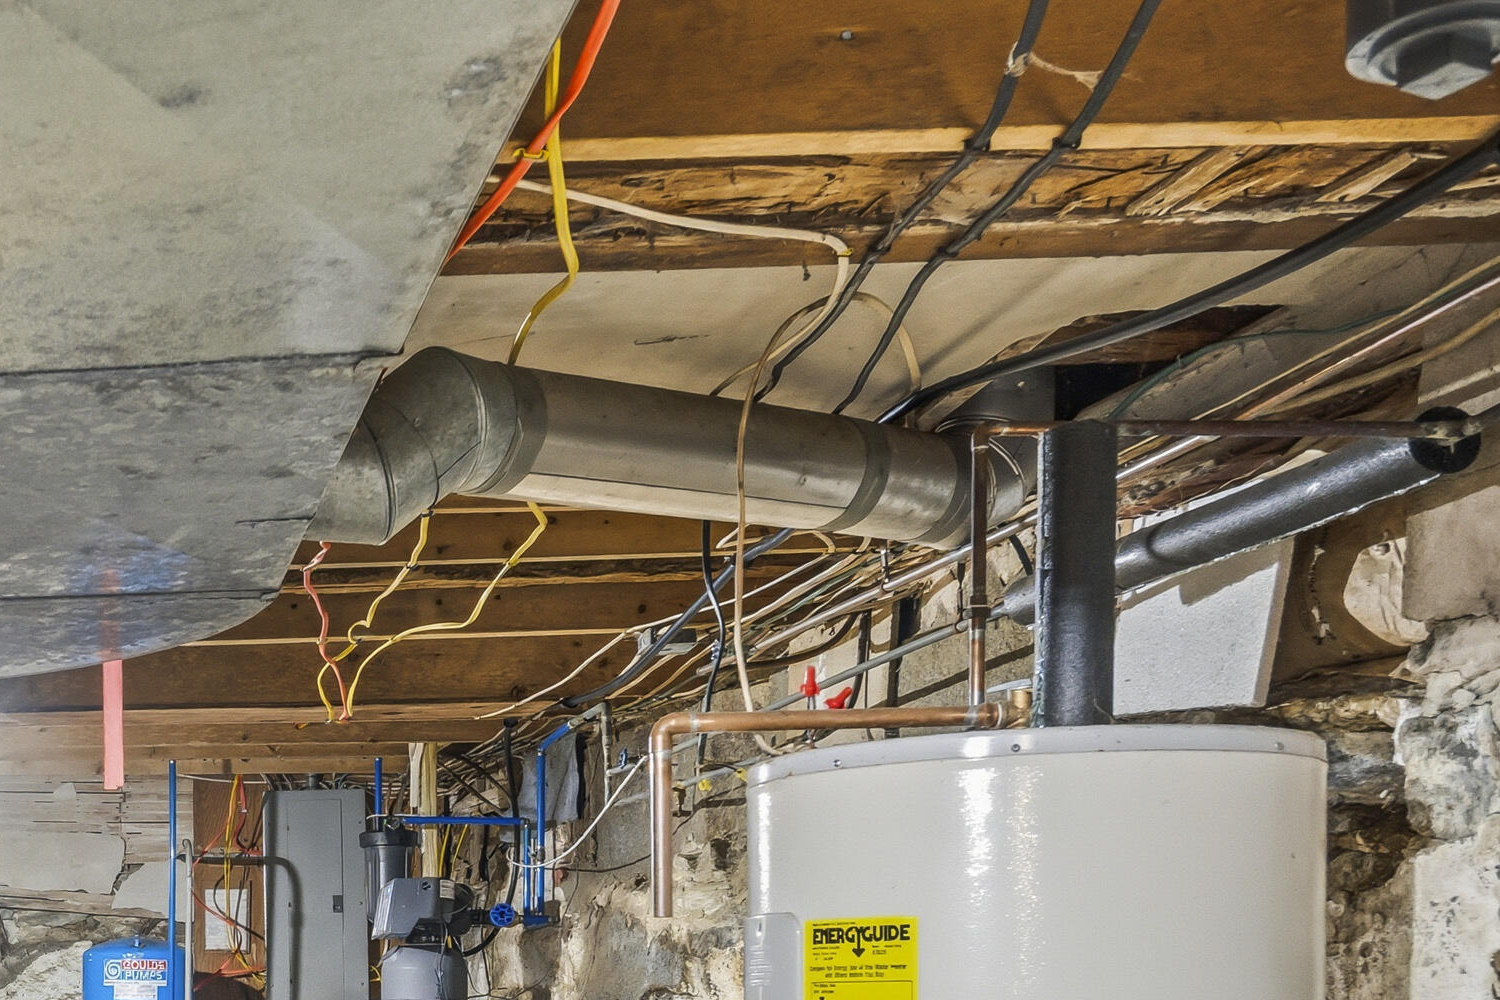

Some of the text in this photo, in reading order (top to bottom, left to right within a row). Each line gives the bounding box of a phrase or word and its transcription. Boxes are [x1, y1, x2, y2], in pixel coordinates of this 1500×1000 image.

[812, 924, 911, 946] ENERGYGUIDE
[123, 959, 166, 970] GOULDS
[125, 970, 163, 980] PUMPS
